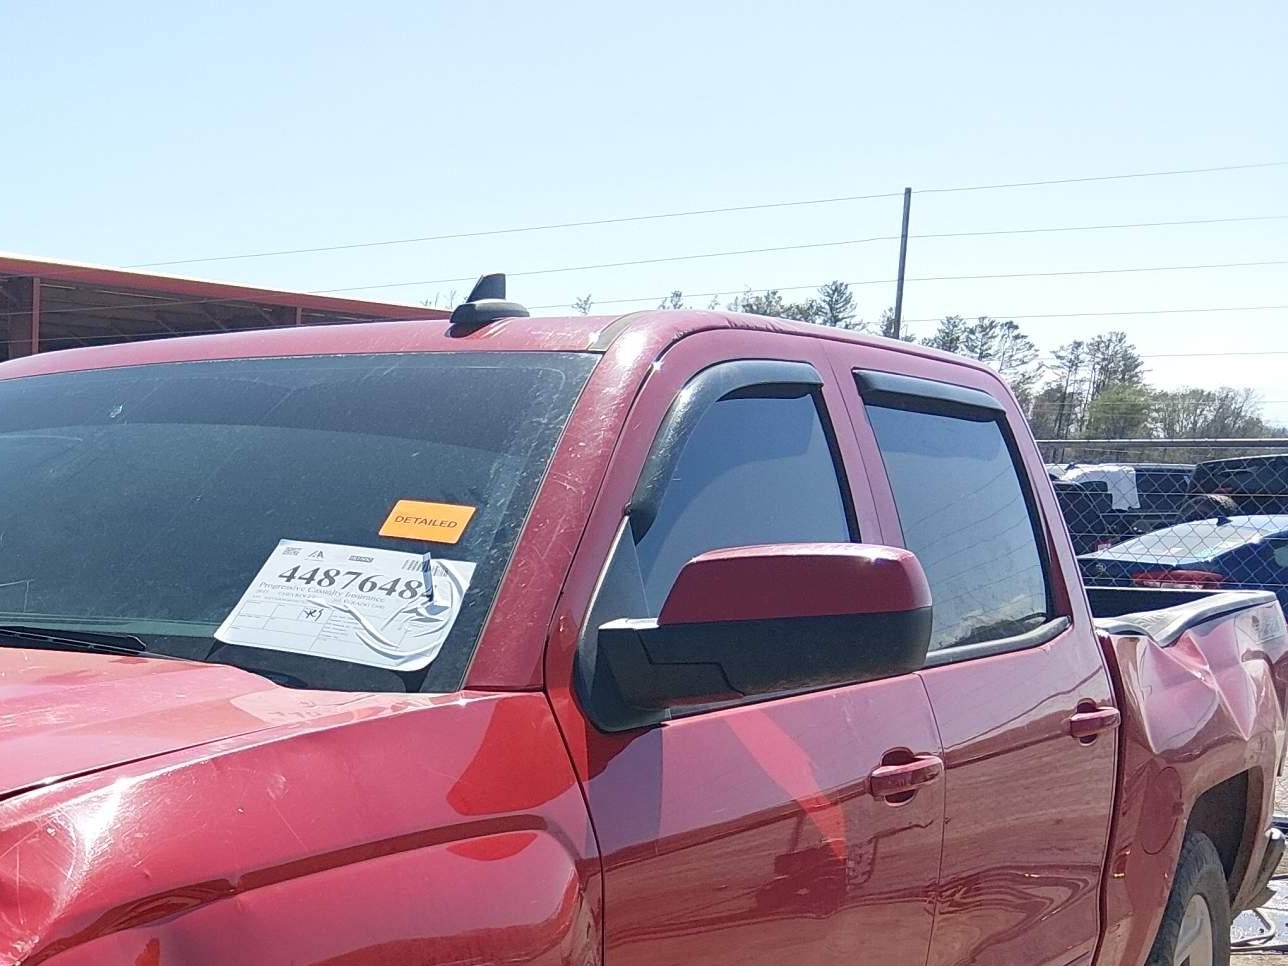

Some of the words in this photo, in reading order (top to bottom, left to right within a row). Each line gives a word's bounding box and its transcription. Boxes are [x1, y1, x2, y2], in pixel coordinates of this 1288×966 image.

[394, 515, 459, 529] DETAILED
[259, 581, 305, 592] Progressive
[278, 565, 433, 601] 4487648
